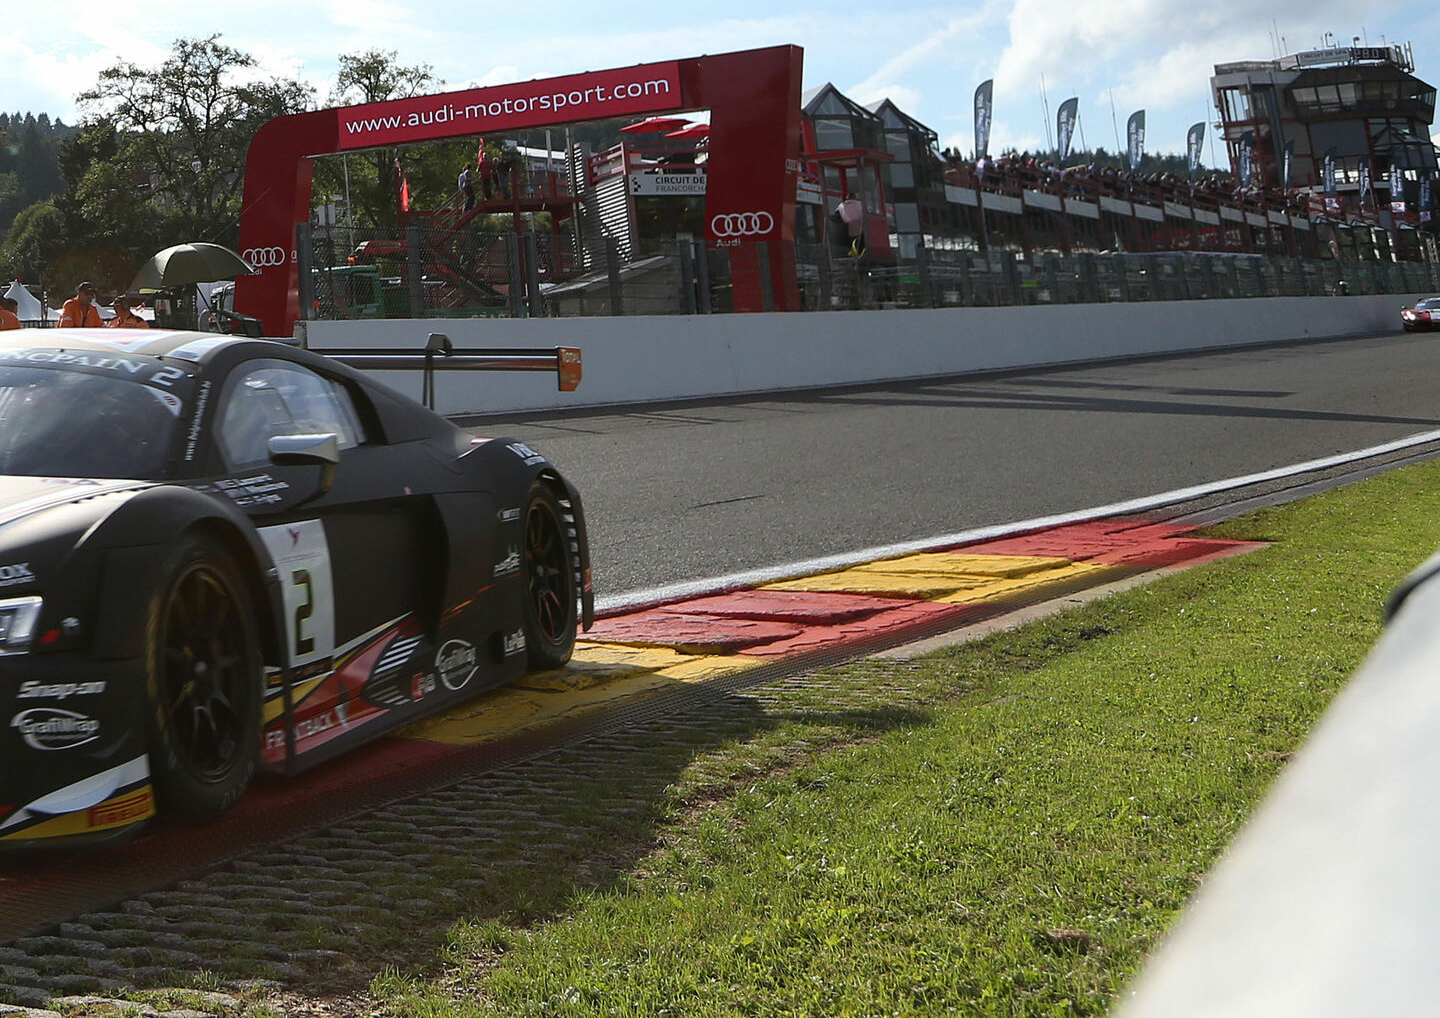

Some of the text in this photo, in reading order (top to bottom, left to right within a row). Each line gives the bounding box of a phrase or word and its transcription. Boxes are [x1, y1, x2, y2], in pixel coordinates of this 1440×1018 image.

[346, 77, 670, 134] www.audi-motorsport.com
[655, 176, 705, 184] CIRCUIT DE
[716, 238, 742, 247] Audi
[150, 366, 185, 387] 2
[291, 566, 317, 660] 2
